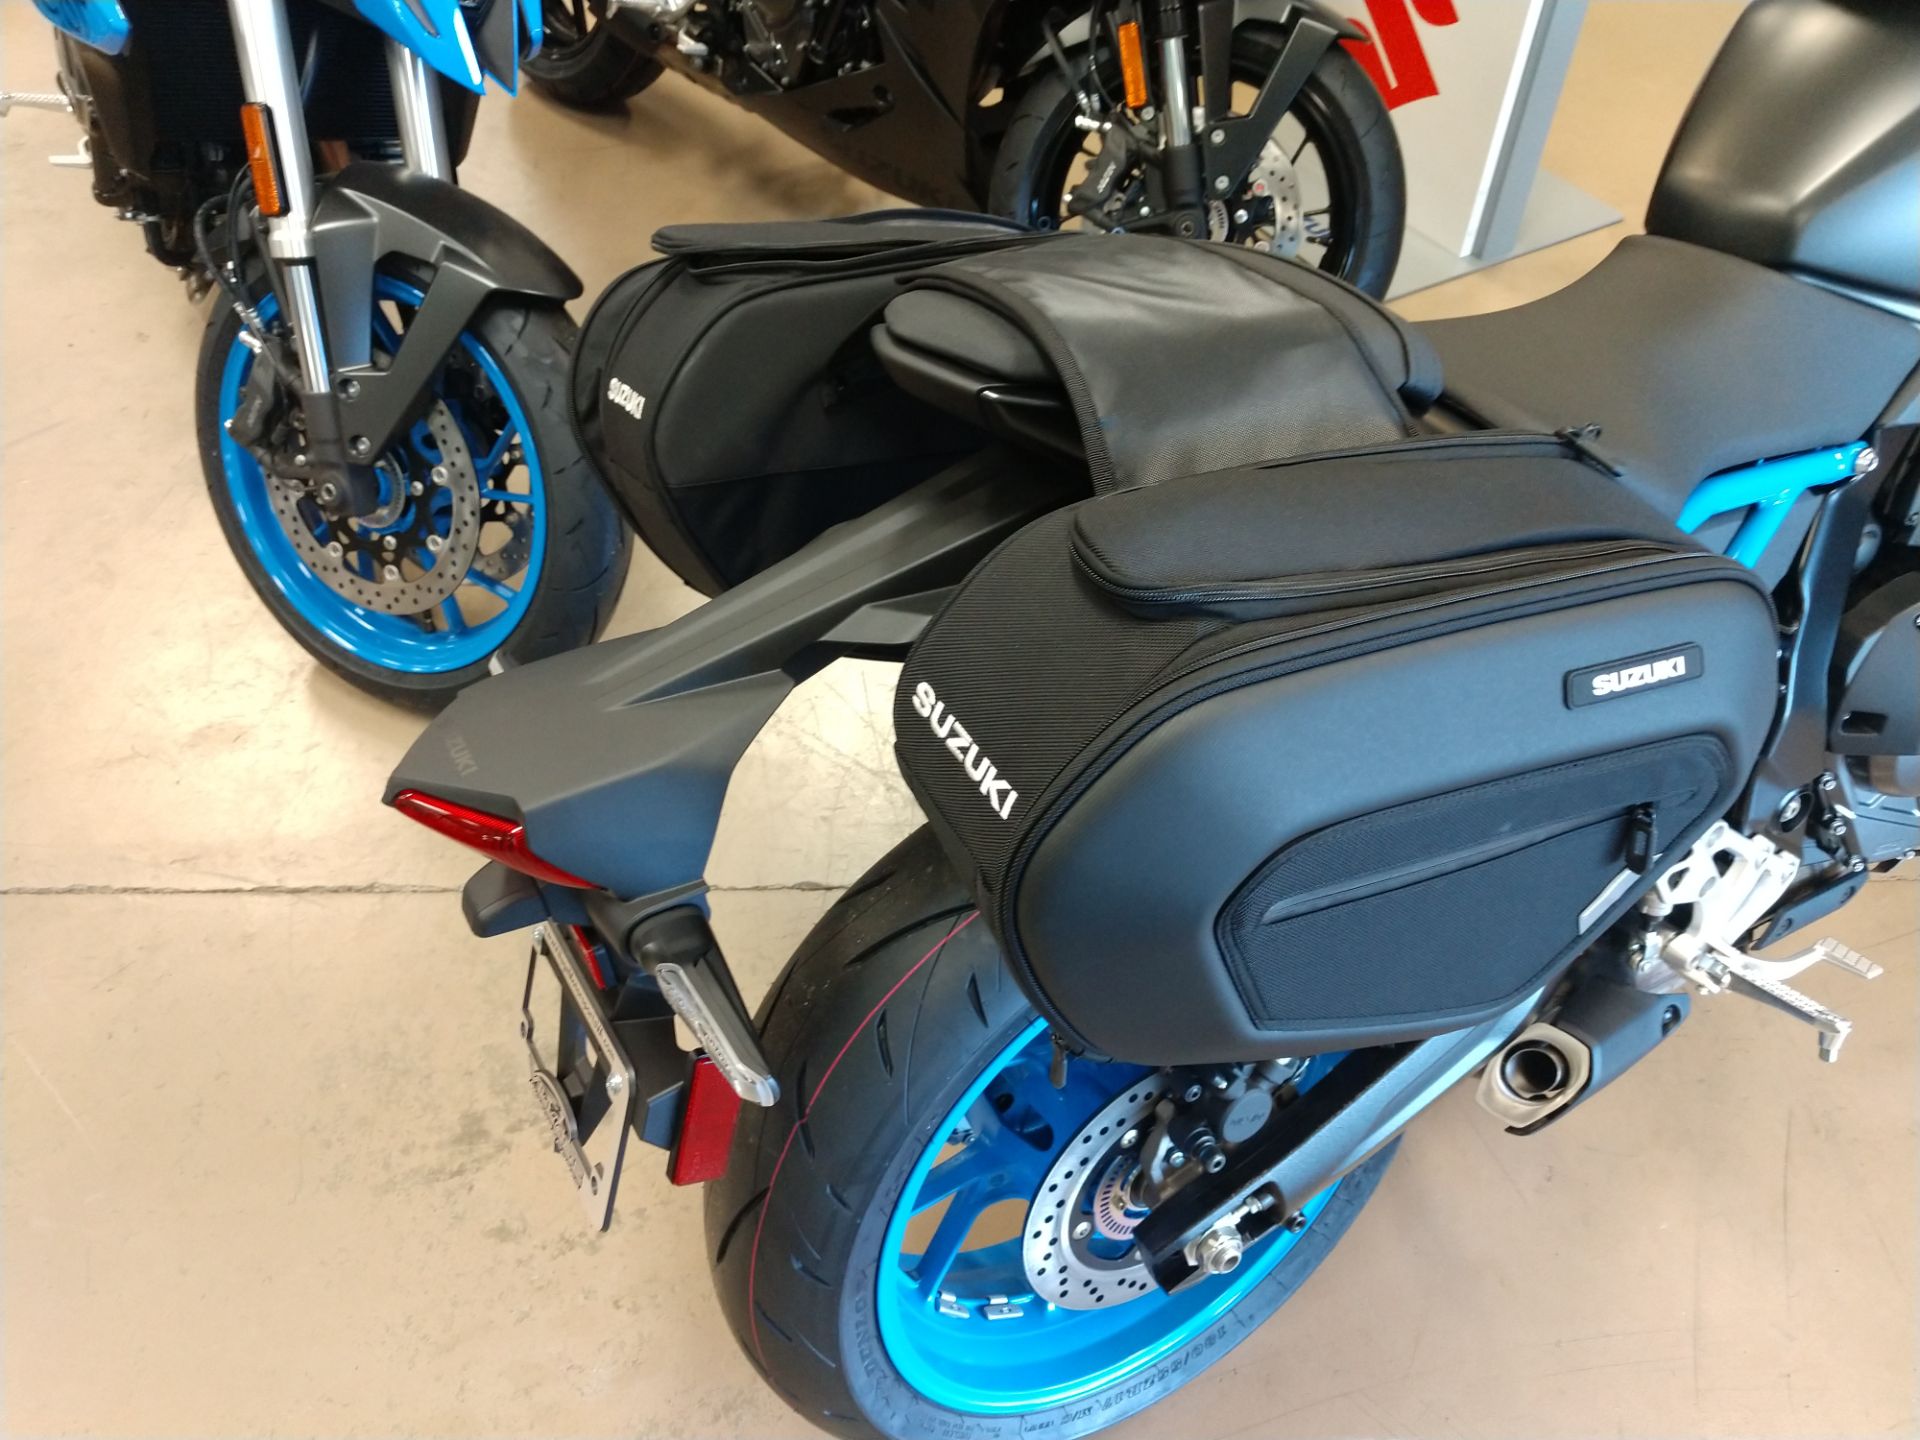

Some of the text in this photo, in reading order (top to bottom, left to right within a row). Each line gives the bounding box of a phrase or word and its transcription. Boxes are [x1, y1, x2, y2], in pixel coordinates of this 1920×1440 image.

[607, 377, 645, 420] SUZUKI
[1592, 655, 1686, 696] SUZUKI
[438, 729, 479, 778] ZUKI
[911, 681, 1018, 820] SUZUKI
[855, 1281, 878, 1379] DUNLO
